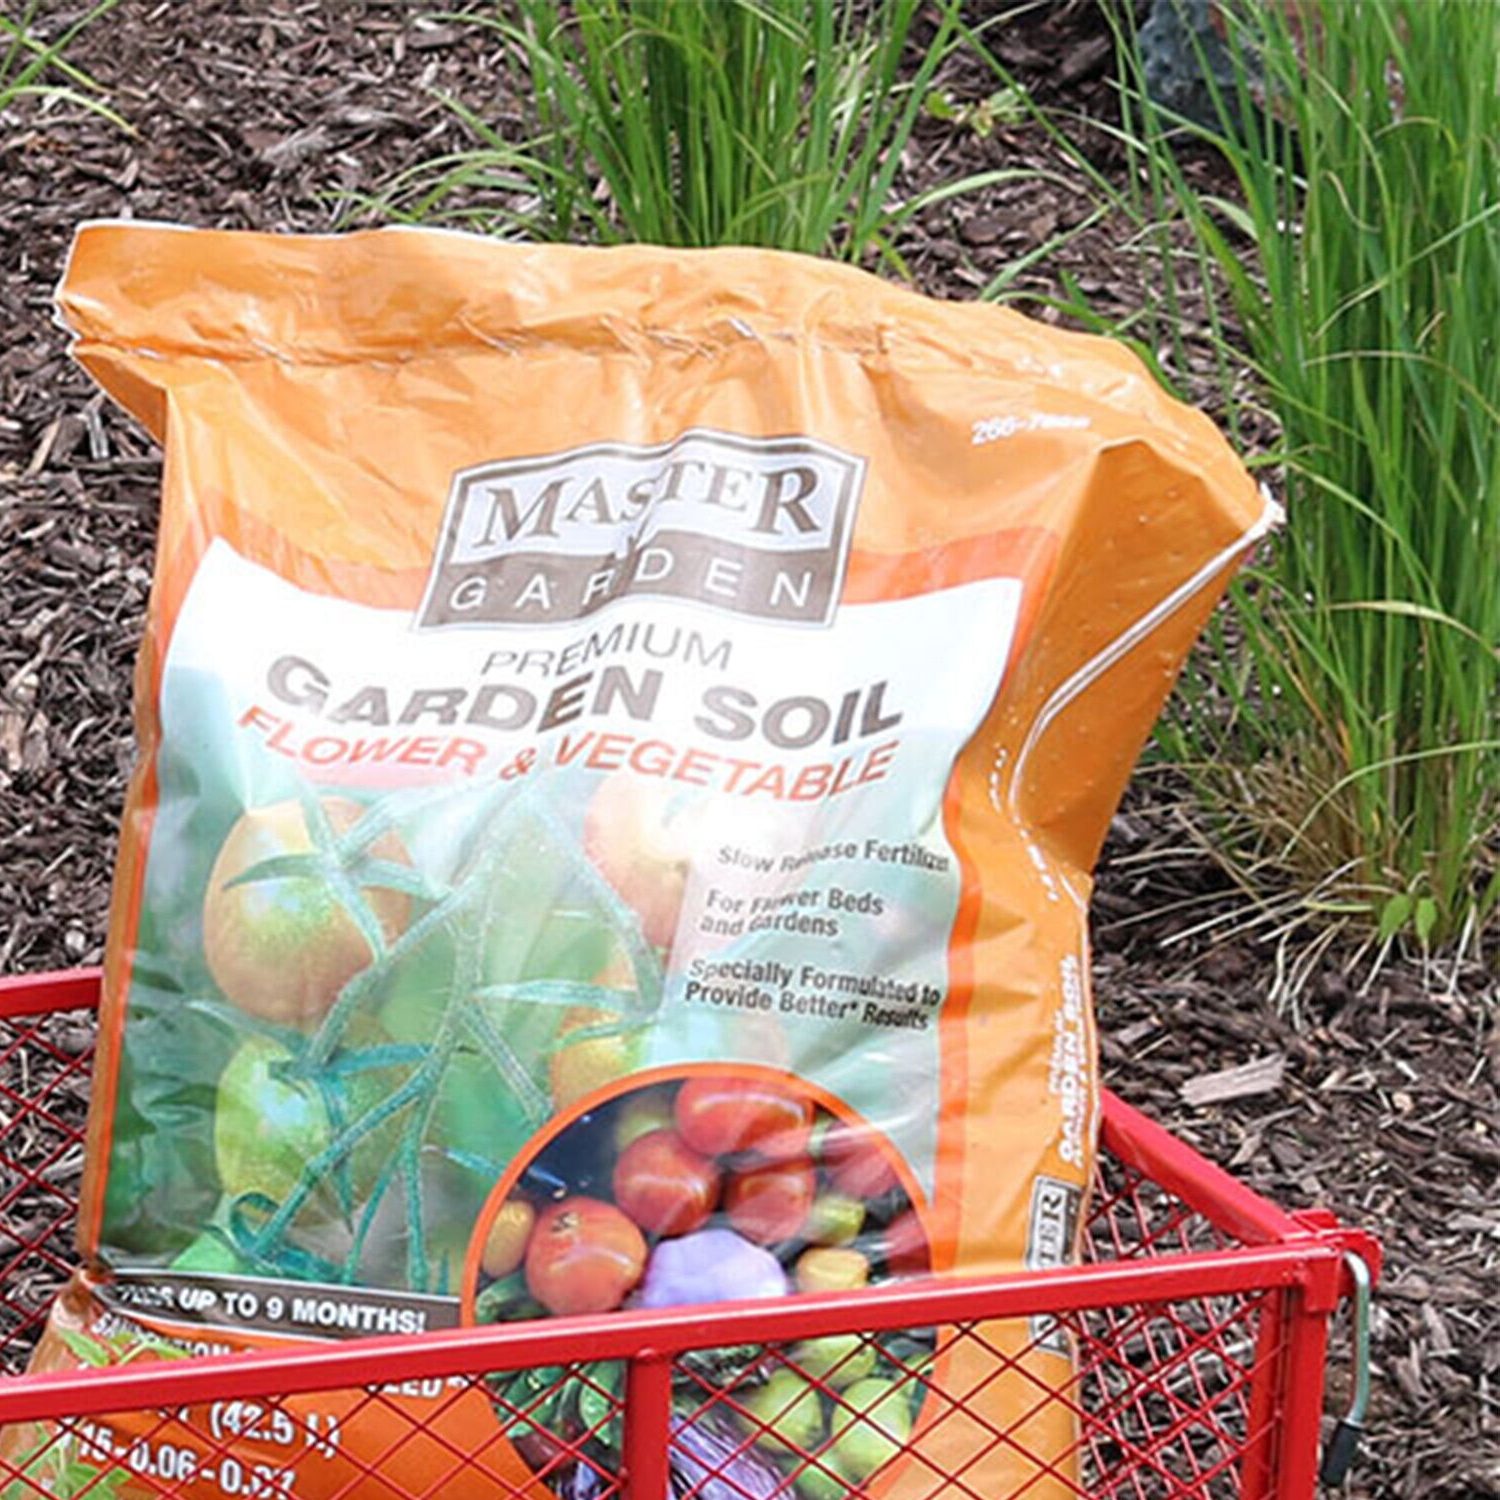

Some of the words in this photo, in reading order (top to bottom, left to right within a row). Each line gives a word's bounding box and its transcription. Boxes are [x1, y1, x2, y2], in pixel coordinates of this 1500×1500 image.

[472, 459, 823, 548] MASTER
[449, 548, 813, 609] GARDEN
[480, 622, 733, 677] PREMIUM
[266, 655, 665, 734] GARDEN
[693, 680, 904, 751] SOIL
[236, 704, 489, 777] FLOWER
[498, 746, 538, 781] &
[553, 733, 901, 803] VEGETABLE
[717, 846, 774, 873] Slow
[701, 913, 744, 937] and
[706, 889, 743, 914] For
[828, 888, 884, 916] Beds
[685, 980, 774, 1011] Provide
[862, 1001, 929, 1031] Results
[689, 957, 794, 989] Specially
[800, 965, 918, 1006] Formulated
[921, 984, 942, 1007] to
[179, 1287, 217, 1311] UP
[224, 1292, 259, 1318] TO
[266, 1297, 285, 1320] 9
[292, 1299, 427, 1333] MONTHS!
